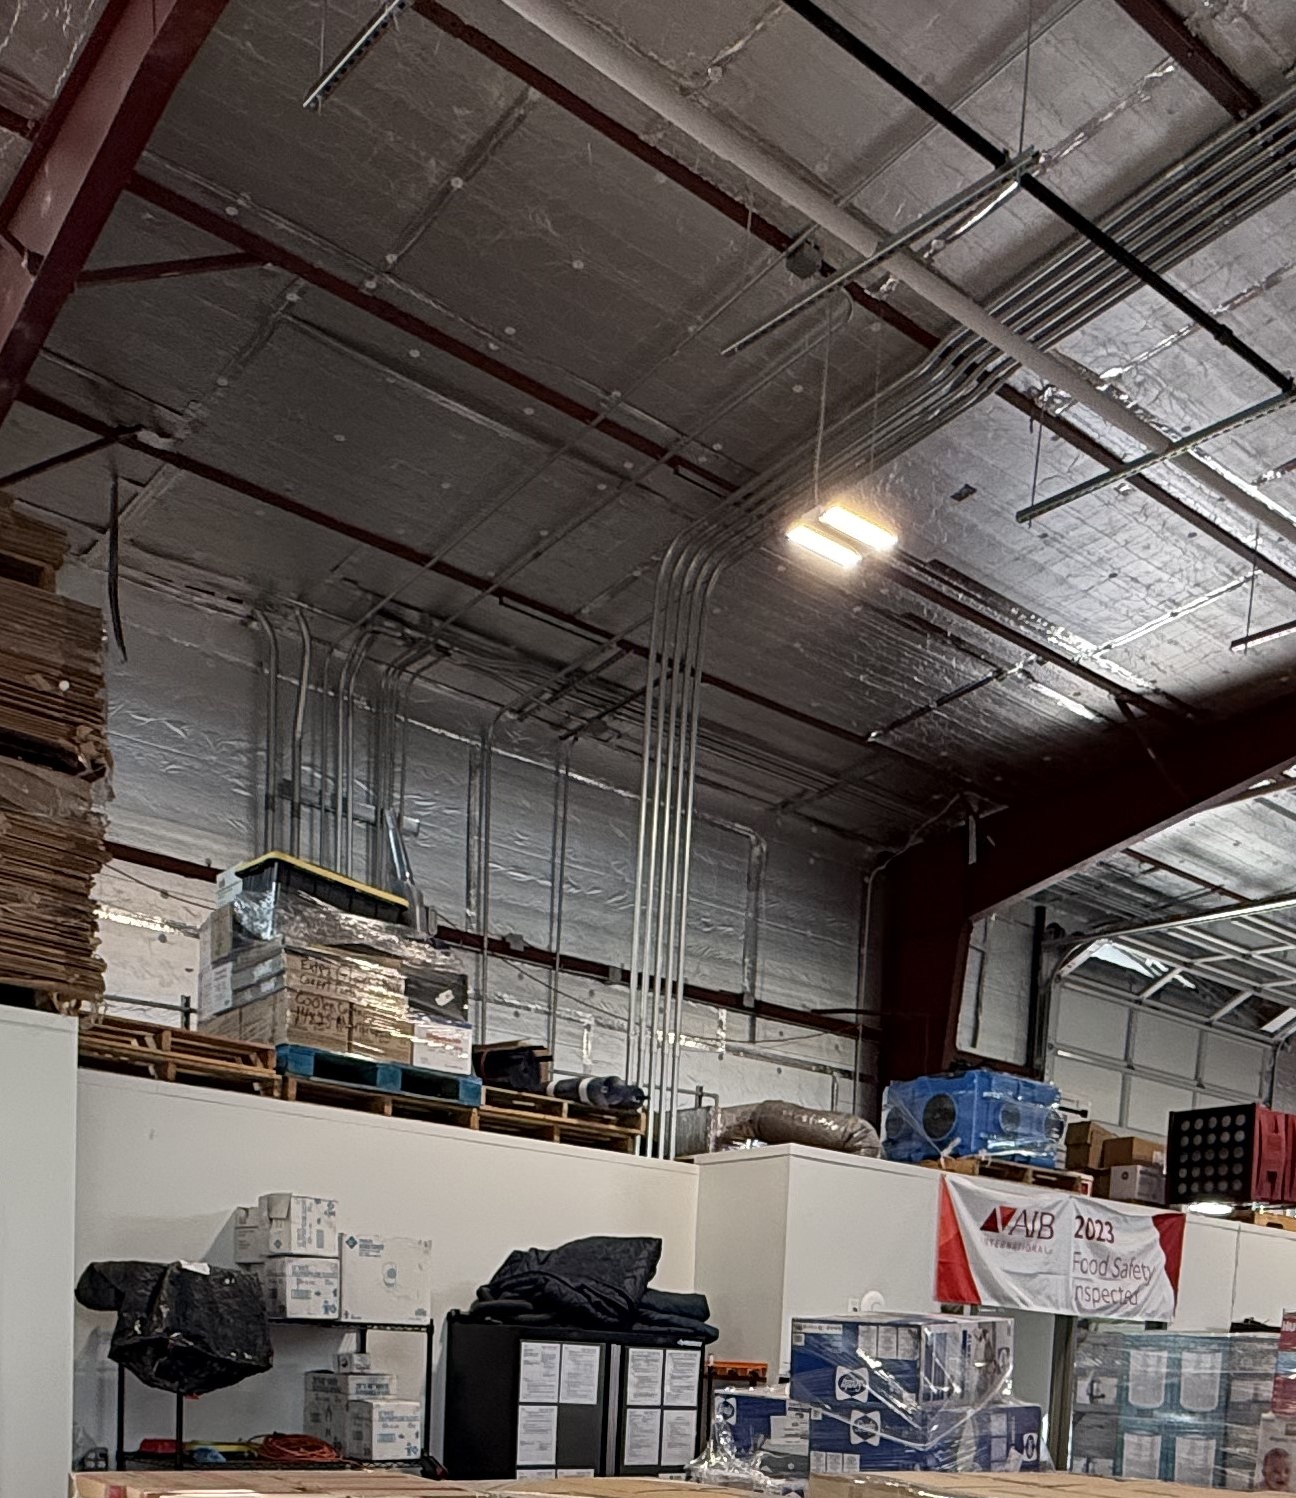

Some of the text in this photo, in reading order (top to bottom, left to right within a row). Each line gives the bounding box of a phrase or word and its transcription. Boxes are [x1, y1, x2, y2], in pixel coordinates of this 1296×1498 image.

[1008, 1209, 1055, 1240] AIB
[1074, 1215, 1114, 1243] 2023
[1073, 1251, 1154, 1287] Food Safety
[1073, 1285, 1140, 1308] nspected
